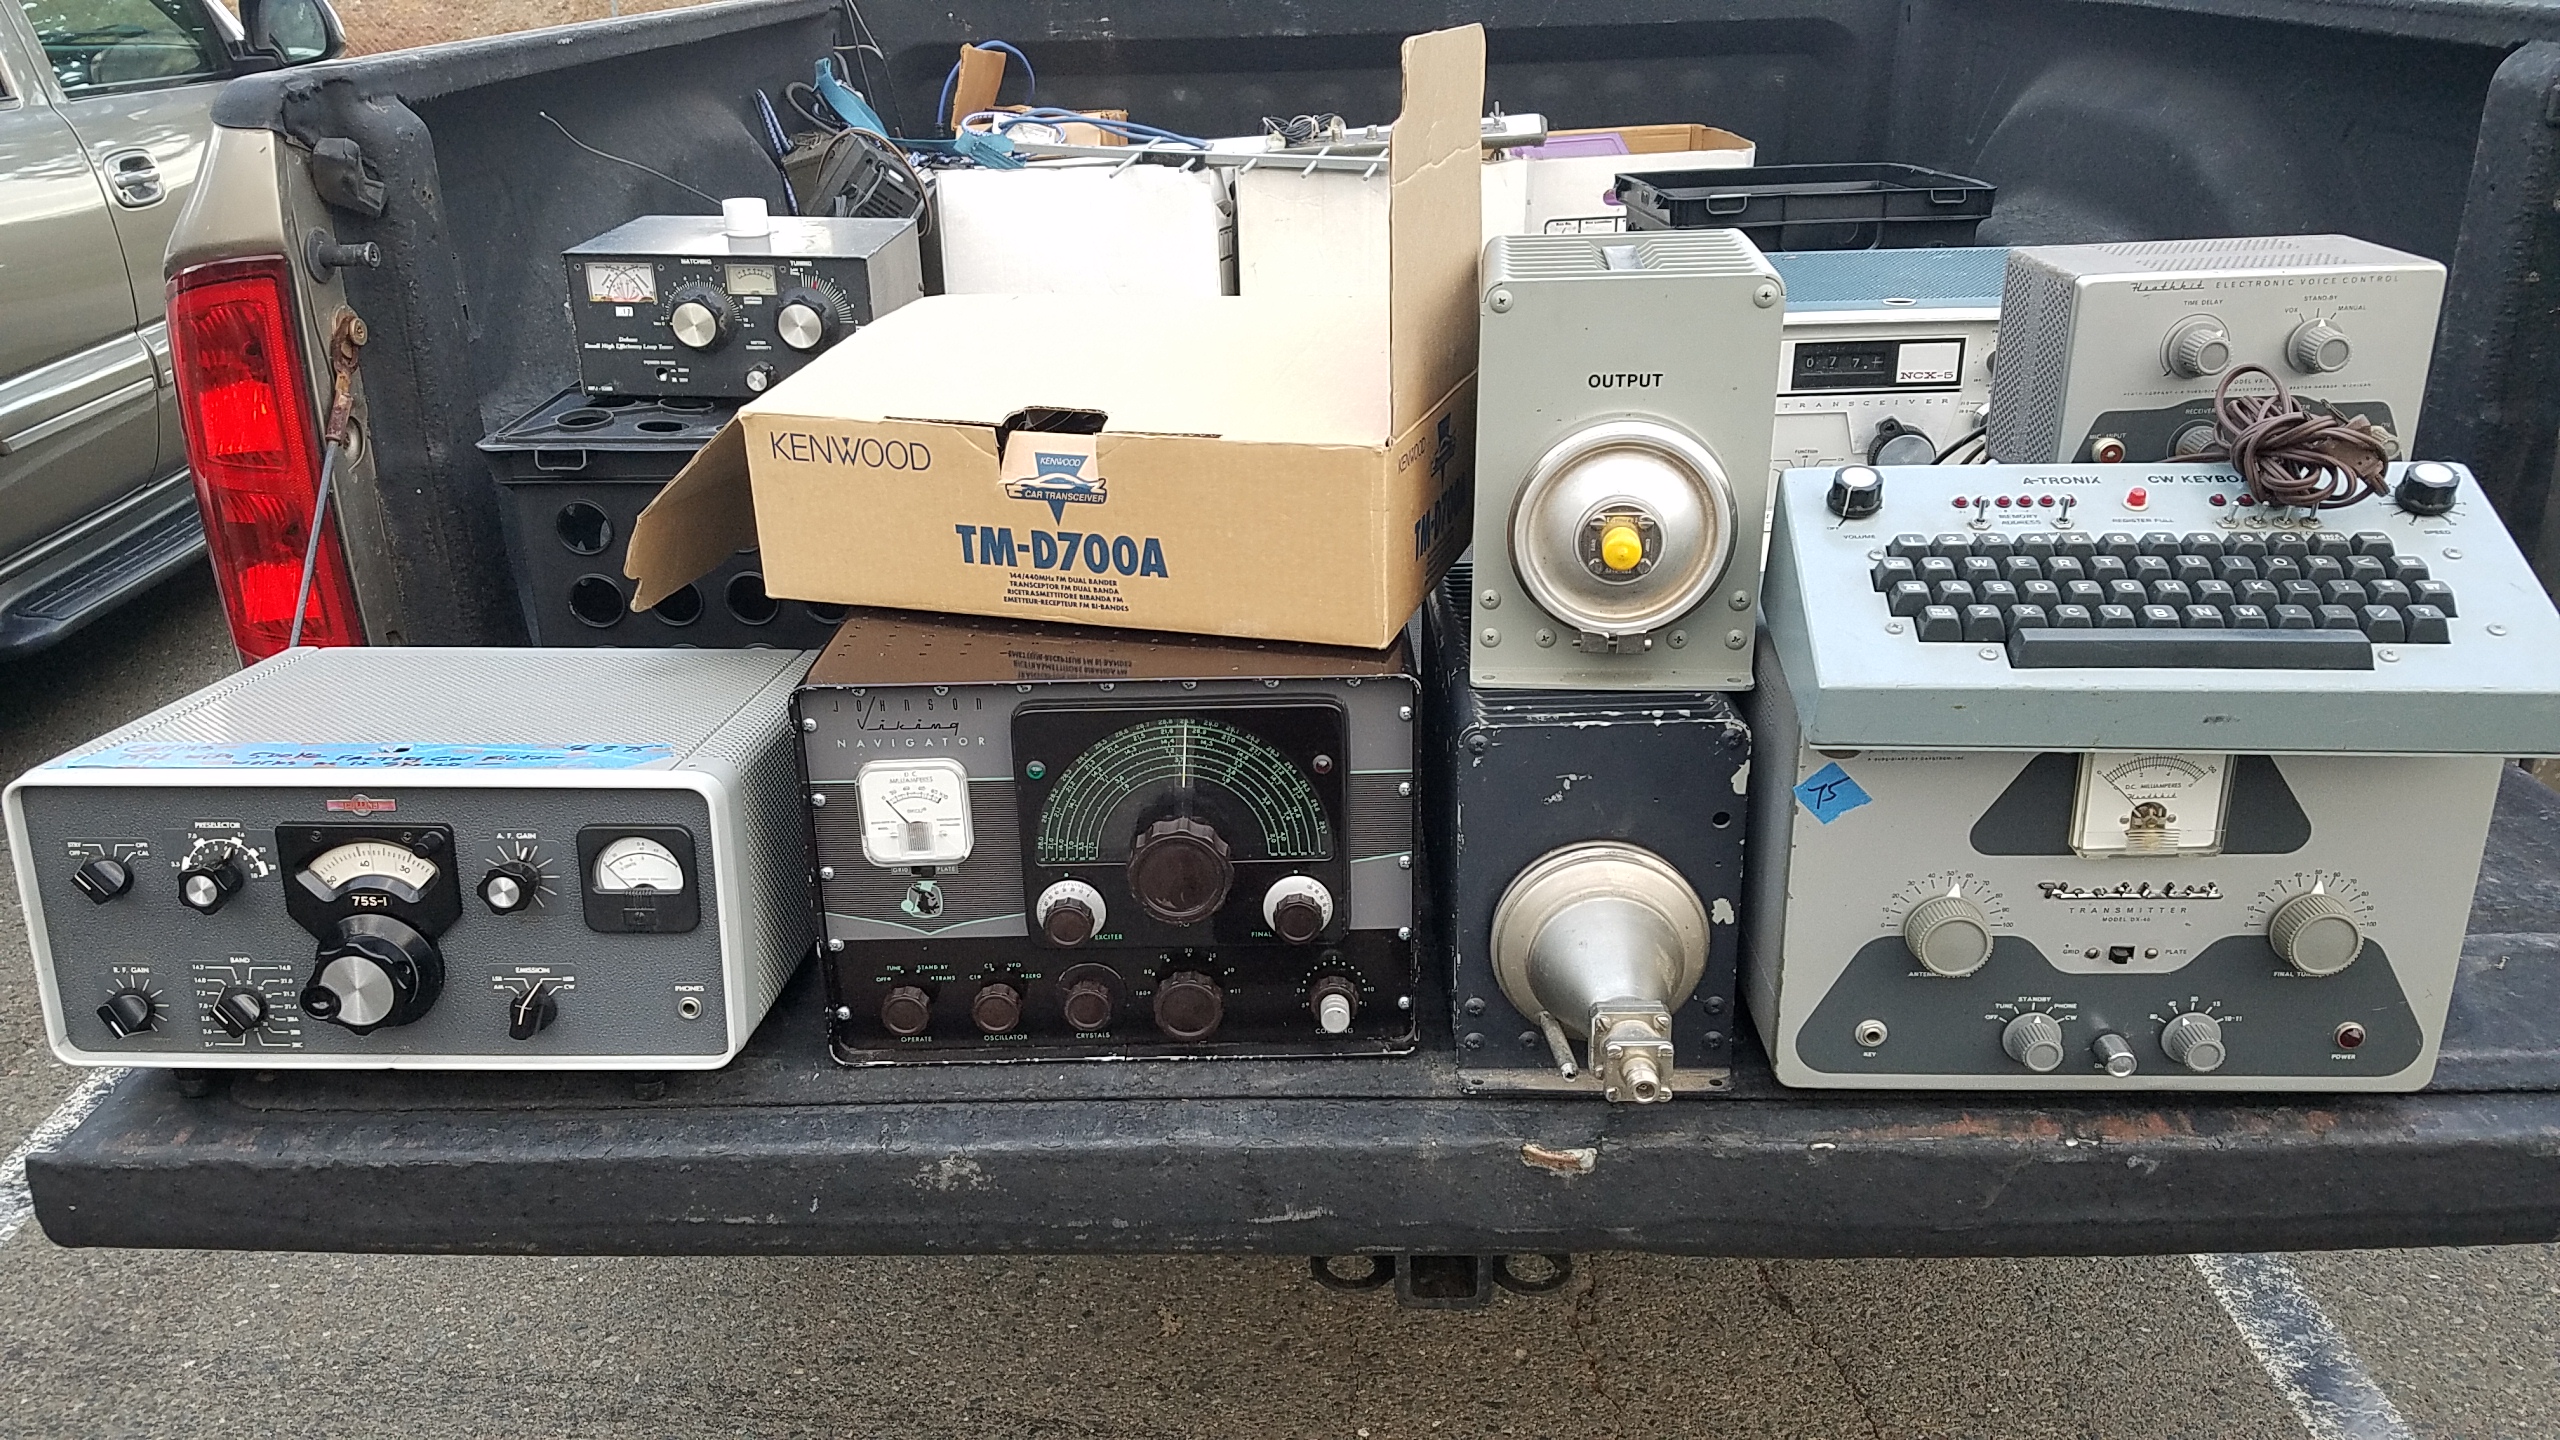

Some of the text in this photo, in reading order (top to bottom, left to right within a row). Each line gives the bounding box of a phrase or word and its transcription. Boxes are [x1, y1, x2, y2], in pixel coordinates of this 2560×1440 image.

[2130, 279, 2205, 293] Heathkit
[2215, 274, 2400, 290] ELECTRONIC VOICE CONTROL
[2337, 304, 2367, 312] MANUAL
[1587, 372, 1664, 389] OUTPUT
[1899, 371, 1954, 380] NCX-5
[1783, 397, 1949, 409] TRANSCEIVER
[769, 431, 932, 472] KENWOOD
[1039, 456, 1081, 468] KENWOOD
[2022, 475, 2102, 486] A-TRONIX
[2147, 474, 2247, 485] CW KEYBOA
[1024, 489, 1105, 503] CAR TRANSCEIVER
[2154, 534, 2167, 542] 7
[954, 523, 1170, 579] TM-D700A
[1930, 557, 2328, 568] Q W E R T Y U P
[1008, 572, 1118, 587] 144/440MHz FM DUAL BANDER
[1009, 580, 1120, 595] TRANSCEPTOR FM DUAL BANDA
[1950, 582, 2309, 592] A F H K L
[1006, 588, 1078, 600] RICETRASMETTITORE
[1079, 594, 1112, 603] BIBANDA
[1003, 596, 1130, 612] EMETTEUR-RECEPTEUR FM BI-BANDES
[1976, 606, 2257, 616] Z X C V N M
[832, 697, 983, 713] JOHNSON
[856, 695, 960, 737] Viking
[835, 736, 986, 749] NAVIGATOR
[1106, 744, 1120, 754] 21.4
[1807, 776, 1852, 810] 75
[194, 821, 241, 829] PRESELECTOR
[2068, 906, 2188, 915] TRANSMITTER
[1094, 933, 1123, 941] EXCITER
[229, 956, 251, 964] BAND
[515, 966, 550, 974] EMISSION
[674, 985, 705, 993] PHONES
[983, 1033, 1029, 1042] OSCILLATOR
[1075, 1031, 1111, 1040] CRYSTALS
